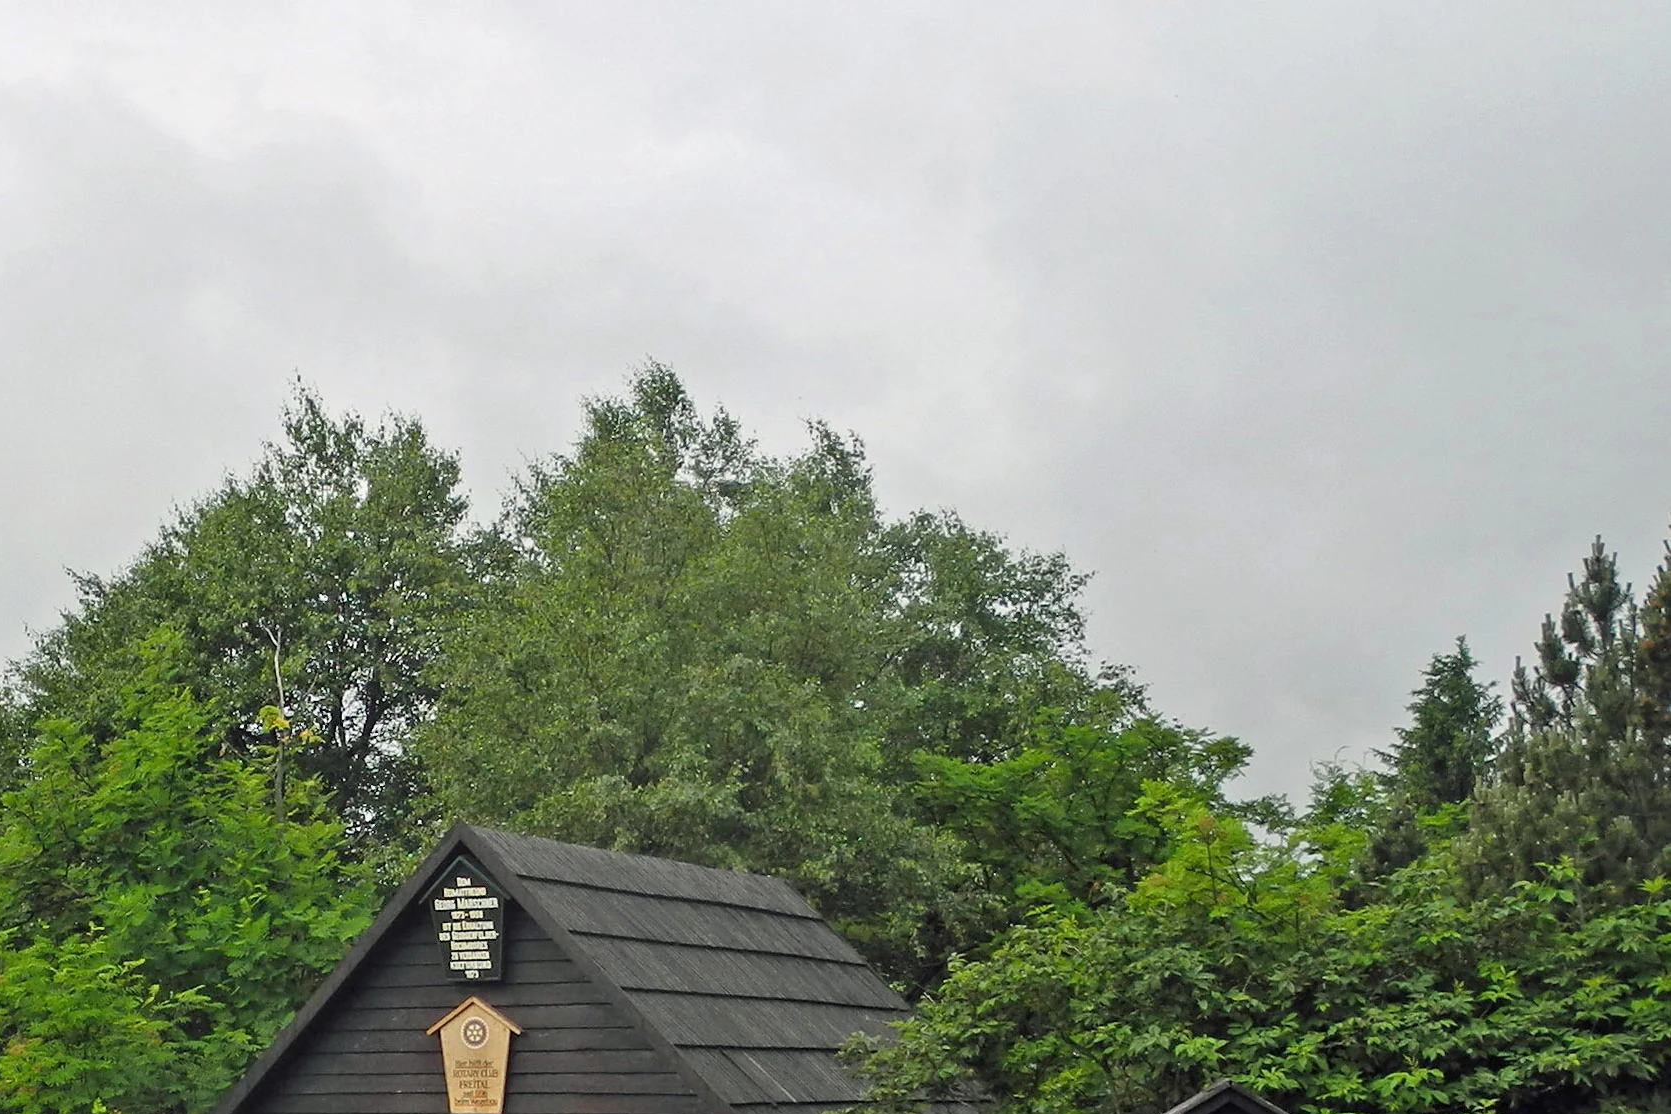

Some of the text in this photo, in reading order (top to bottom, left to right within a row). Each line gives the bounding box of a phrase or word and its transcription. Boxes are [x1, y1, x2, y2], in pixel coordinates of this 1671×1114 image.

[453, 1070, 498, 1078] ROTARY CLUB
[459, 1080, 490, 1088] FREITAL
